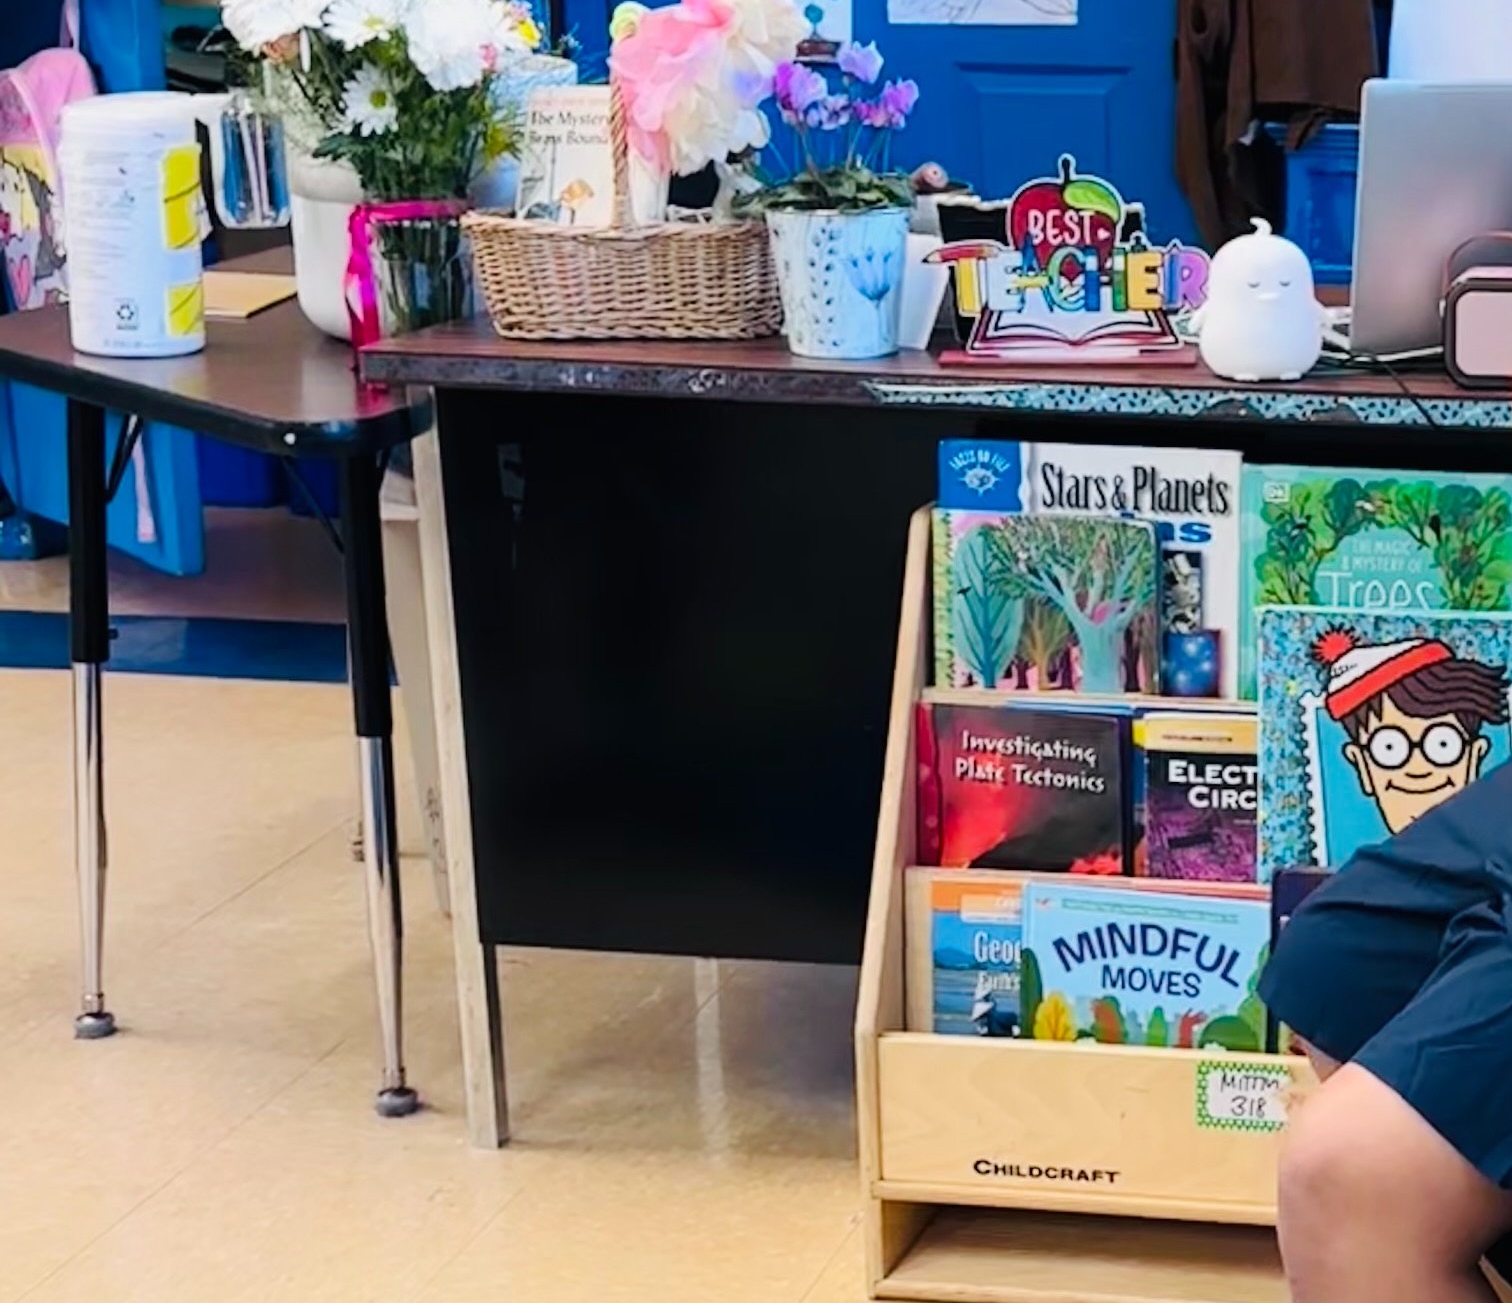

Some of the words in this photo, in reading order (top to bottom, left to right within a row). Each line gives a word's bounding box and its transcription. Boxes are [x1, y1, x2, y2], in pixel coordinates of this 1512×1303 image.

[1027, 208, 1095, 245] BEST
[928, 234, 1210, 314] TEACHER
[1041, 462, 1109, 510] Stars
[1111, 477, 1128, 511] &
[1132, 466, 1231, 516] Planets
[961, 730, 1097, 769] Investigating
[954, 757, 1004, 783] Plate
[1011, 763, 1105, 794] Tectonics
[1053, 922, 1242, 989] MINDFUL
[1101, 964, 1202, 998] MOVES
[1231, 1095, 1267, 1119] 318
